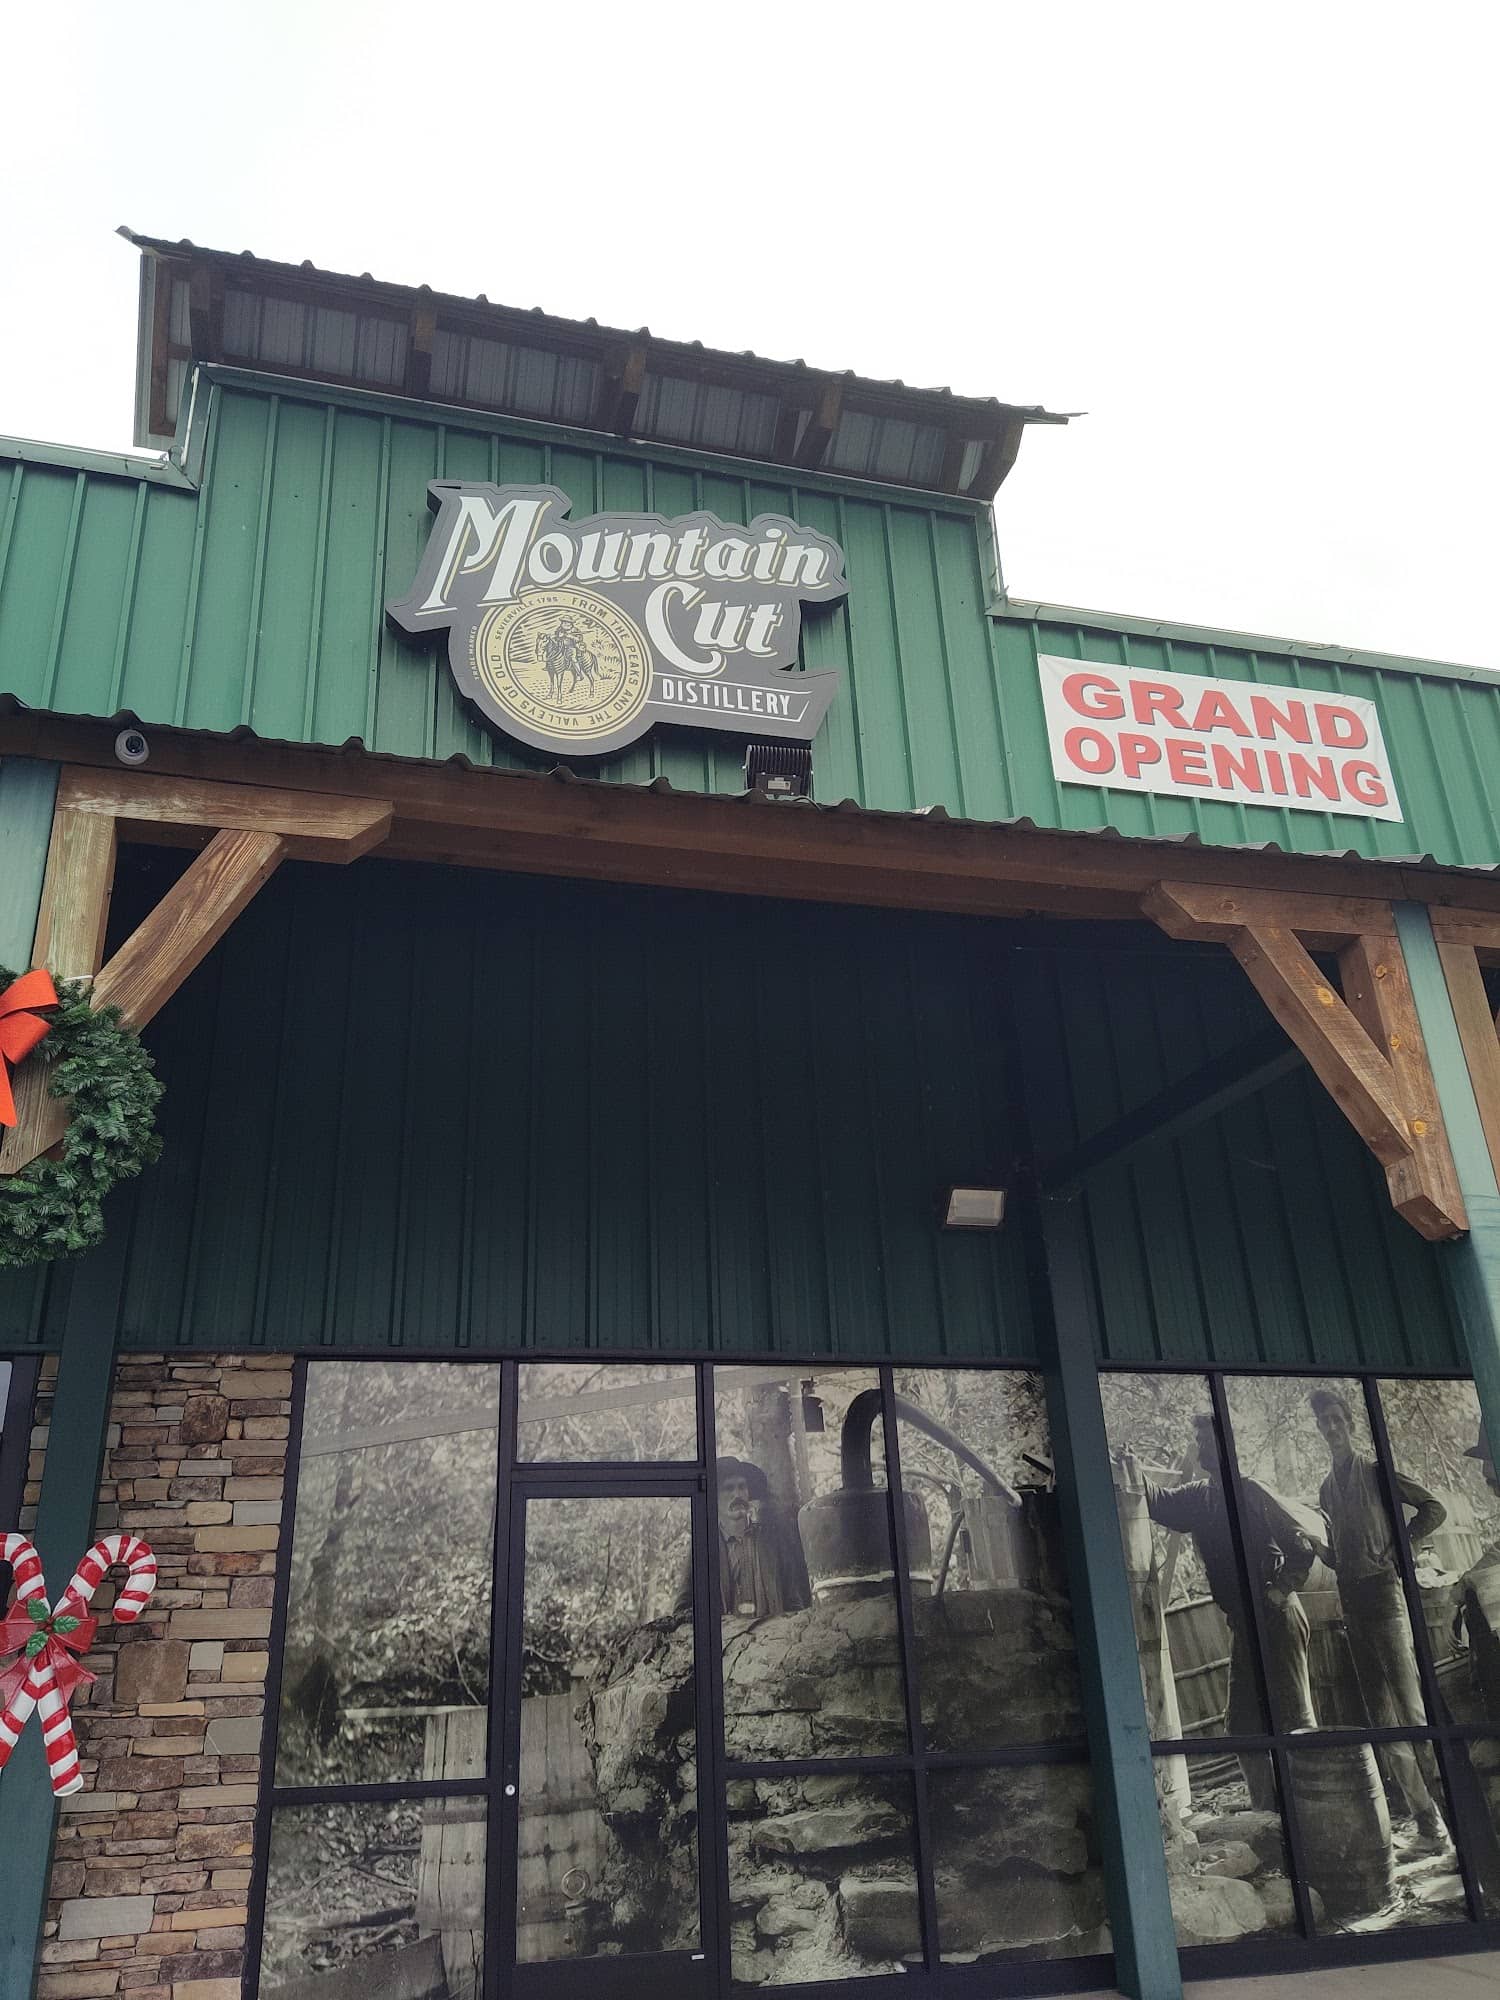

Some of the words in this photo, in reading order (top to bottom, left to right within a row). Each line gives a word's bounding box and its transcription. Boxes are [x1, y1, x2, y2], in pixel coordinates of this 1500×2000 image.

[419, 496, 831, 610] Mountain
[571, 597, 608, 619] FROM
[610, 616, 631, 641] THE
[645, 580, 783, 674] Cut
[490, 654, 505, 679] OLD
[626, 645, 640, 687] PEAKS
[502, 685, 519, 700] OF
[616, 689, 632, 712] AND
[662, 678, 791, 716] DISTILLERY
[519, 701, 579, 727] VALLEYS
[590, 710, 612, 725] THE
[1062, 673, 1368, 750] GRAND
[1063, 726, 1389, 807] OPENING
